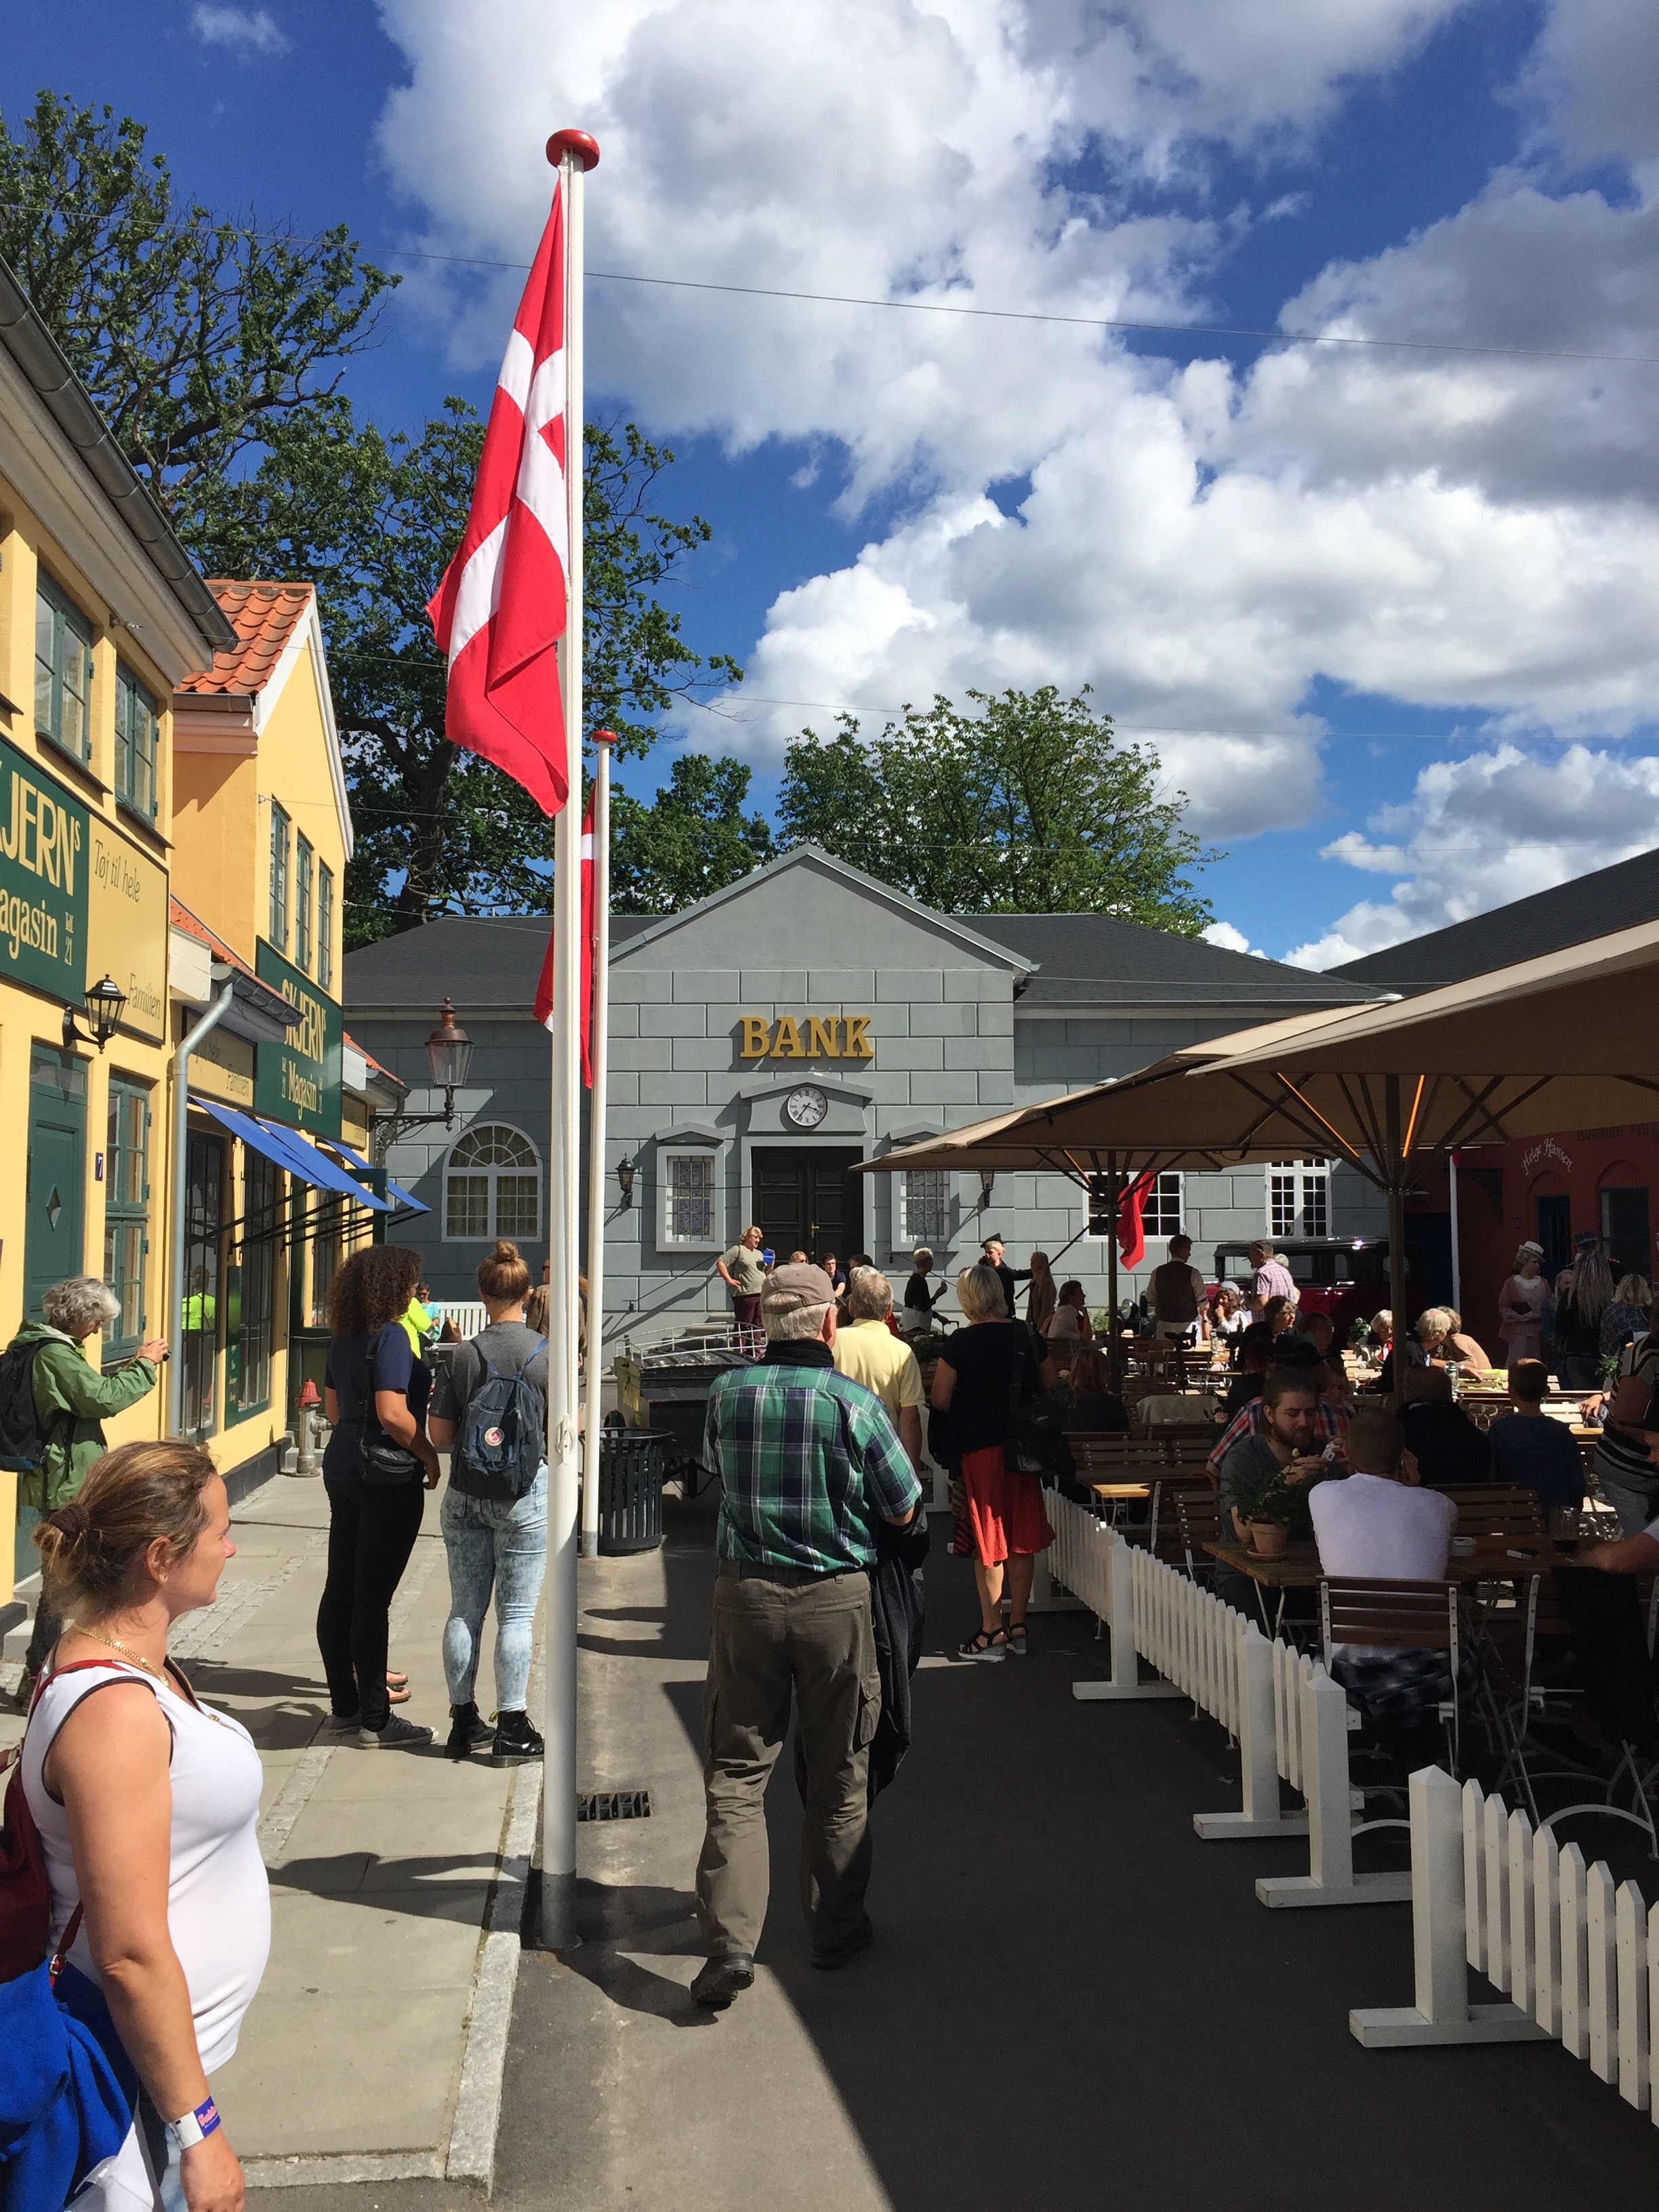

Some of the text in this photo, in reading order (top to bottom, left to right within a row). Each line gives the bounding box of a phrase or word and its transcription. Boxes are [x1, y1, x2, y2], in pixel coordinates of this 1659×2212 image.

[0, 760, 81, 897] JERNS
[95, 839, 140, 903] Tøj til hele
[127, 972, 161, 1020] Familien
[740, 1017, 874, 1058] BANK
[289, 1061, 316, 1121] Magasin
[98, 1156, 103, 1178] 7
[1521, 1137, 1573, 1176] Helge Hansen
